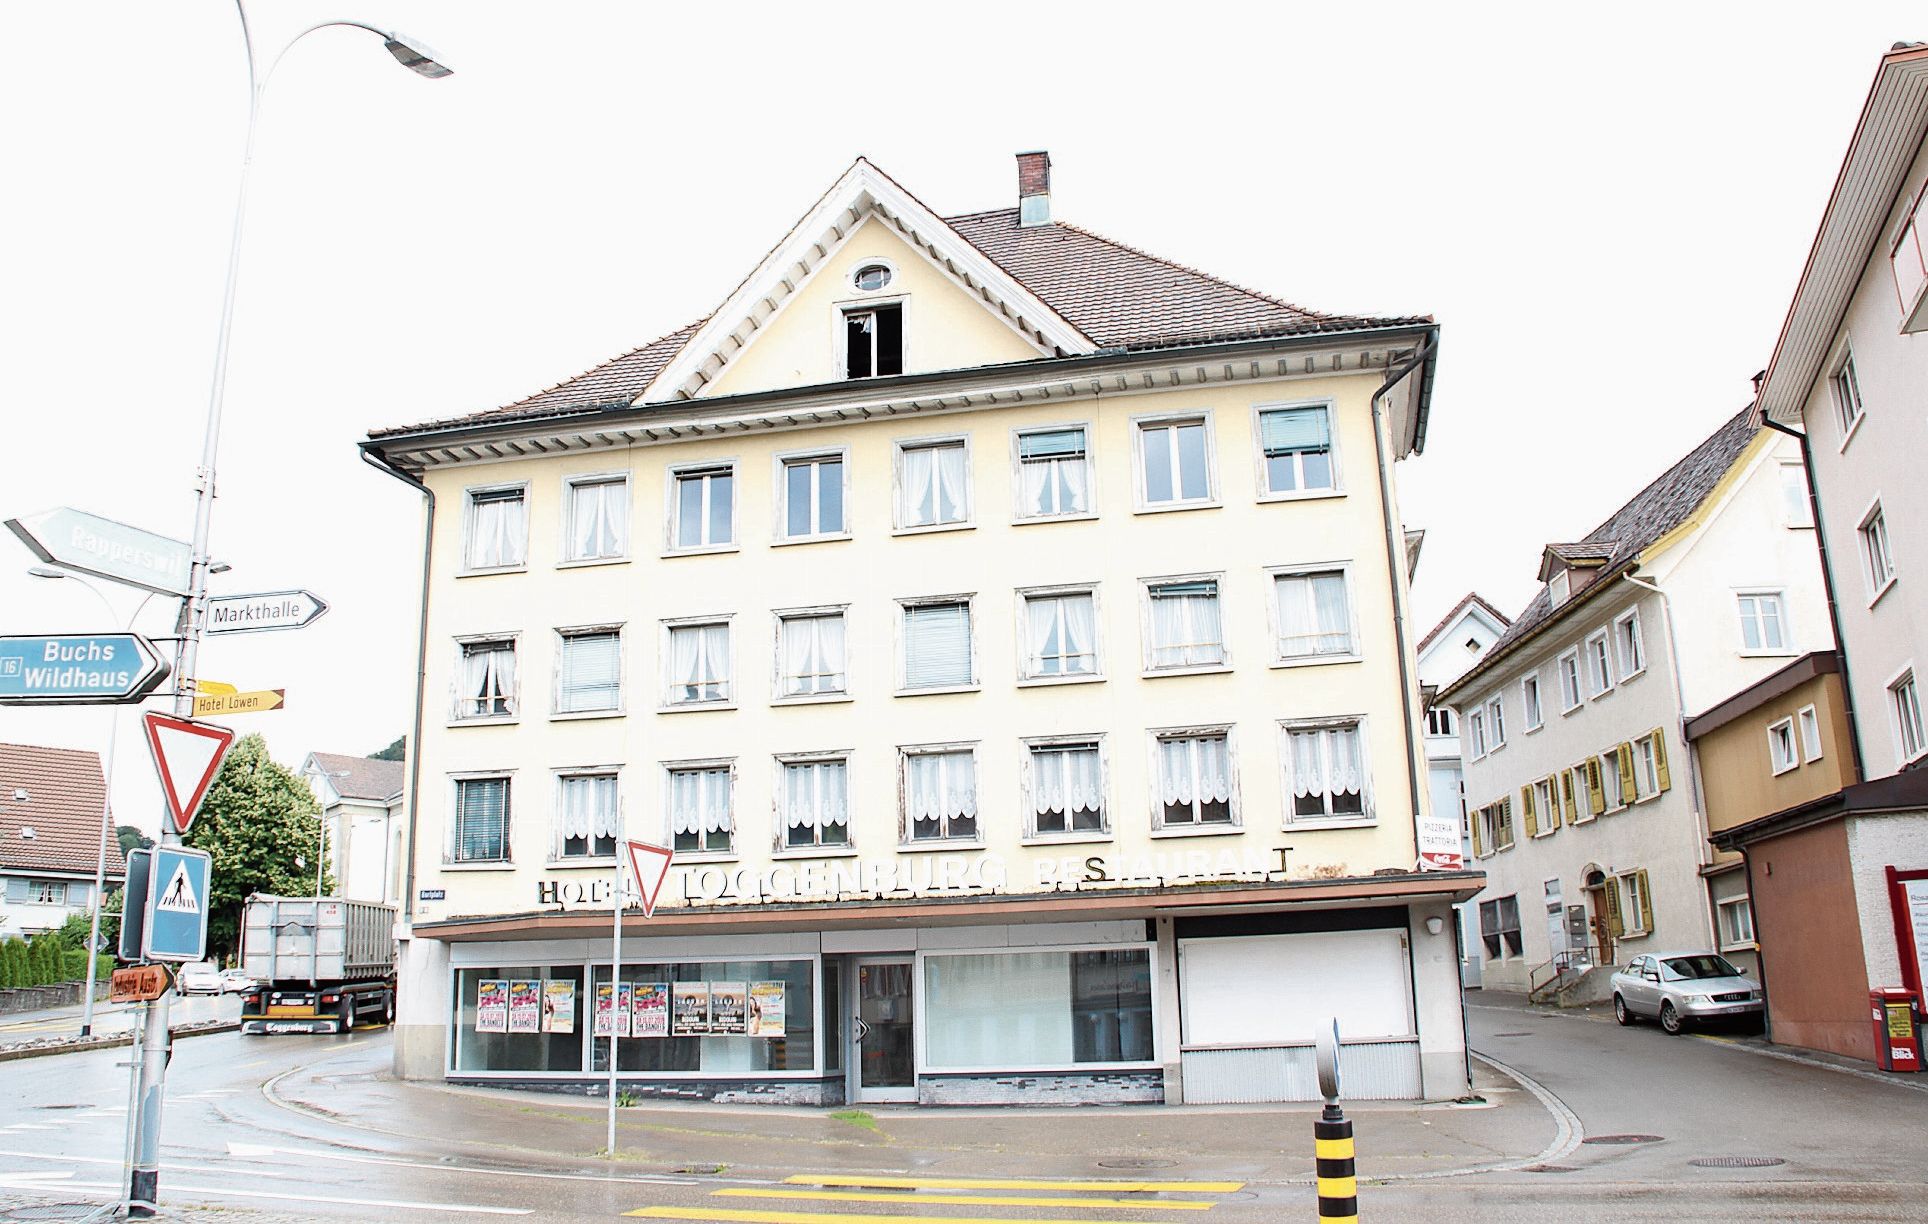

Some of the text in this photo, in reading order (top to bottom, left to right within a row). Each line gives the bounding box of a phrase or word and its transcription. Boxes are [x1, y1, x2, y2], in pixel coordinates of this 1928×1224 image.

[71, 524, 182, 577] Rapperswil
[214, 602, 300, 624] Markthalle
[44, 640, 116, 662] Buchs
[4, 660, 17, 674] 16
[24, 666, 129, 689] Wildhaus
[199, 694, 259, 712] Hotel Löwen
[1424, 822, 1453, 833] PIZZERIA
[1422, 835, 1458, 847] TRATTORIA
[676, 852, 1008, 900] TOGGENBURG
[1036, 847, 1295, 884] RESTAURANT
[266, 1022, 314, 1033] Toggenburg
